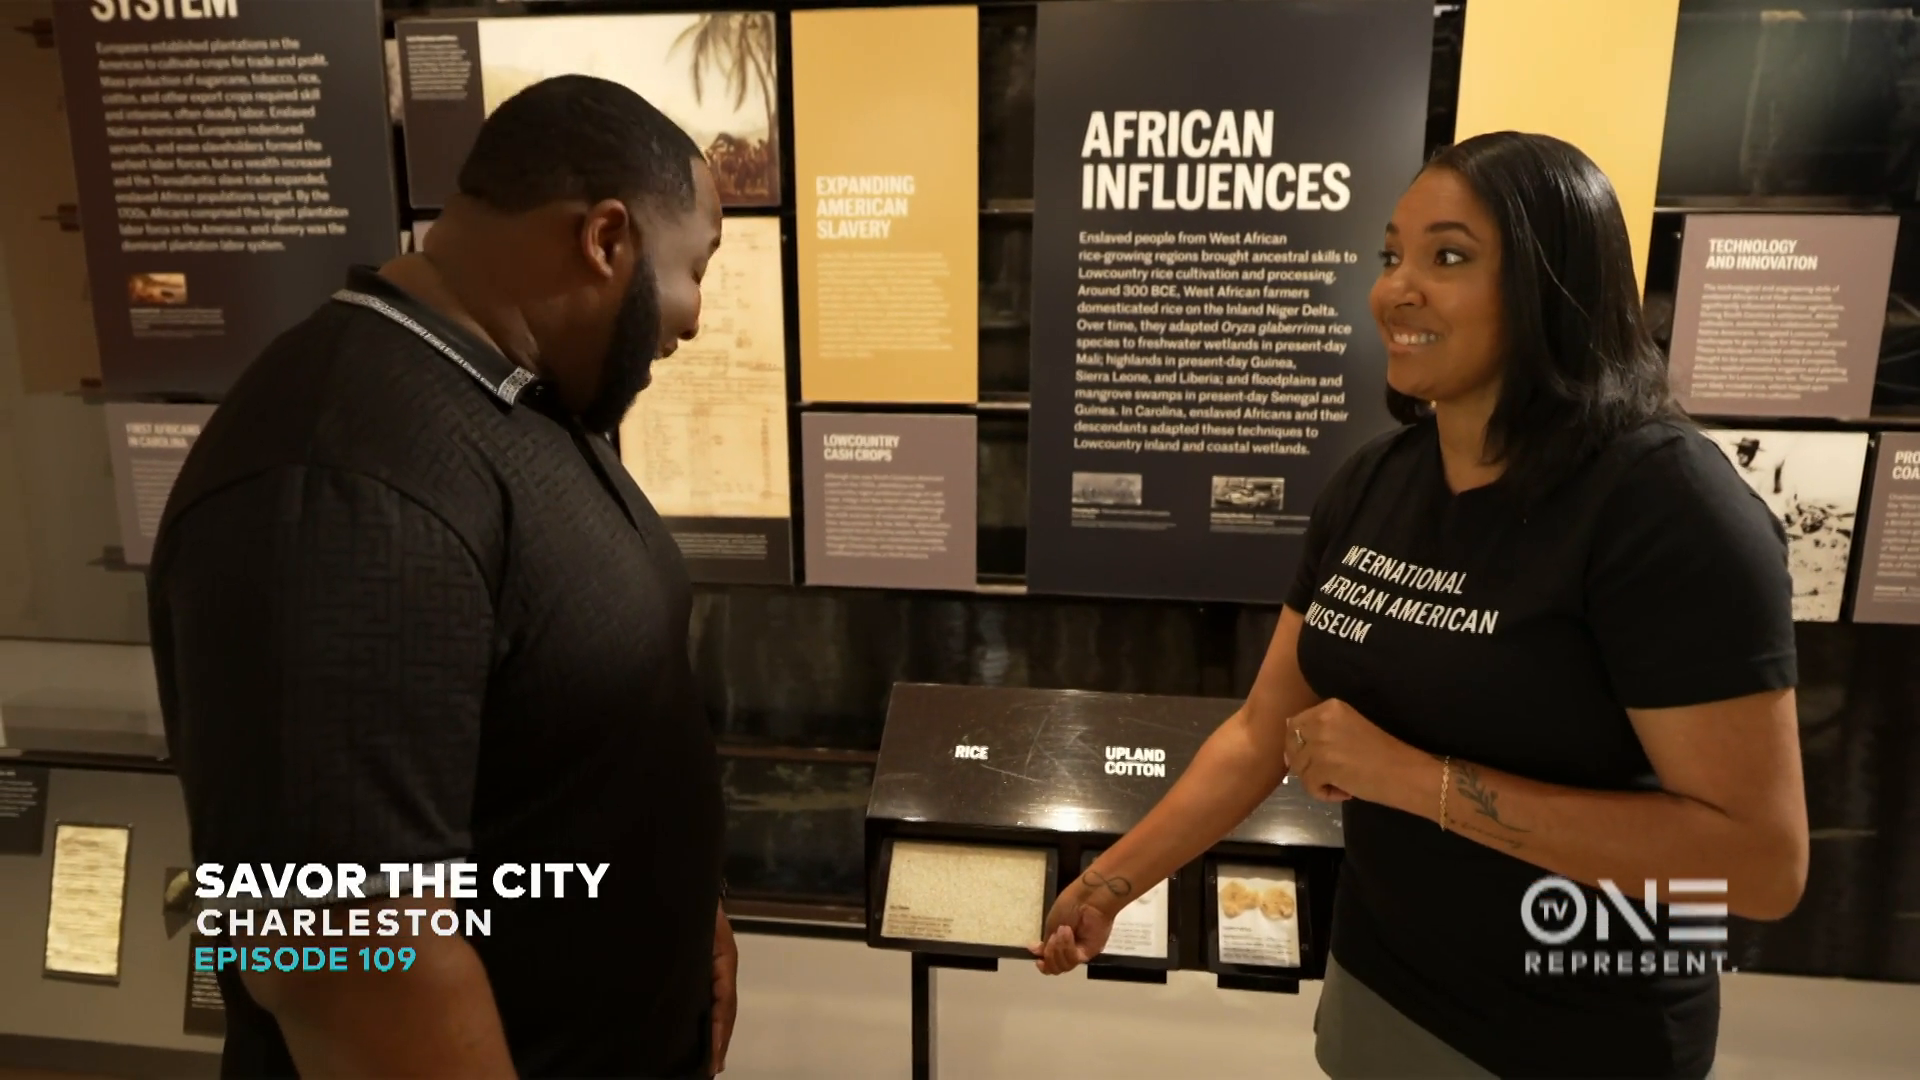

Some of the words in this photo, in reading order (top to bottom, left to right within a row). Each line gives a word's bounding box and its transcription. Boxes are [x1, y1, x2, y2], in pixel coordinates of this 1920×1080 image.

[1081, 109, 1274, 158] AFRICAN
[815, 175, 915, 195] EXPANDING
[1081, 162, 1351, 211] INFLUENCES
[815, 197, 909, 217] AMERICAN
[816, 219, 891, 239] SLAVERY
[1078, 231, 1132, 243] Enslaved
[1134, 231, 1176, 247] people
[1178, 232, 1206, 244] from
[1209, 232, 1240, 244] West
[1243, 232, 1288, 244] African
[1708, 238, 1799, 254] TECHNOLOGY
[1078, 249, 1152, 265] rice-growing
[1154, 250, 1198, 265] regions
[1200, 250, 1249, 265] brought
[1252, 250, 1309, 263] ancestral
[1311, 251, 1341, 263] skills
[1344, 251, 1358, 263] to
[1705, 255, 1735, 270] AND
[1736, 255, 1819, 271] INNOVATION
[1078, 267, 1148, 282] Lowcountry
[1150, 267, 1174, 280] rice
[1175, 268, 1239, 280] cultivation
[1241, 268, 1265, 280] and
[1266, 268, 1336, 284] processing.
[1077, 284, 1120, 297] Around
[1122, 285, 1148, 297] 300
[1150, 285, 1180, 300] BCE,
[1183, 285, 1214, 298] West
[1217, 286, 1260, 298] African
[1262, 286, 1310, 299] farmers
[1076, 301, 1158, 314] domesticated
[1160, 302, 1183, 315] rice
[1185, 306, 1201, 315] on
[1203, 303, 1224, 315] the
[1226, 303, 1264, 316] Inland
[1266, 304, 1298, 319] Niger
[1302, 304, 1338, 317] Delta.
[1076, 318, 1104, 331] Over
[1107, 319, 1136, 334] time,
[1140, 319, 1166, 335] they
[1168, 320, 1219, 335] adapted
[1221, 320, 1256, 336] Oryza
[1258, 321, 1326, 337] glaberrima
[1328, 322, 1352, 335] rice
[1076, 335, 1120, 351] species
[1122, 336, 1136, 348] to
[1138, 336, 1201, 349] freshwater
[1204, 337, 1259, 350] wetlands
[1261, 338, 1272, 351] in
[1274, 339, 1347, 355] present-day
[1075, 353, 1103, 368] Mali;
[1106, 353, 1162, 369] highlands
[1164, 354, 1176, 367] in
[1178, 355, 1248, 371] present-day
[1250, 356, 1296, 372] Guinea,
[1074, 370, 1110, 382] Sierra
[1112, 371, 1150, 386] Leone,
[1154, 371, 1176, 384] and
[1178, 372, 1223, 388] Liberia;
[1226, 373, 1249, 386] and
[1251, 374, 1317, 390] floodplains
[1319, 375, 1343, 388] and
[1074, 389, 1132, 403] mangrove
[1134, 391, 1182, 404] swamps
[1184, 389, 1196, 401] in
[1198, 389, 1268, 406] present-day
[1270, 391, 1320, 407] Senegal
[1322, 392, 1345, 405] and
[1074, 403, 1118, 416] Guinea.
[1121, 404, 1132, 417] In
[1134, 405, 1186, 421] Carolina,
[1188, 406, 1241, 420] enslaved
[1243, 408, 1292, 421] Africans
[1294, 409, 1318, 422] and
[1320, 410, 1348, 422] their
[1073, 420, 1148, 434] descendants
[1150, 422, 1200, 438] adapted
[1201, 423, 1234, 436] these
[1236, 424, 1302, 441] techniques
[1305, 426, 1319, 439] to
[823, 434, 900, 449] LOWCOUNTRY
[1073, 436, 1142, 453] Lowcountry
[1144, 438, 1180, 451] inland
[1182, 439, 1204, 452] and
[1206, 440, 1250, 454] coastal
[1252, 442, 1311, 457] wetlands.
[824, 447, 854, 461] CASH
[855, 448, 893, 463] CROPS
[1320, 573, 1391, 615] AFRICAN
[1385, 597, 1500, 636] AMERICAN
[954, 745, 989, 760] RICE
[1105, 746, 1166, 763] UPLAND
[1104, 761, 1166, 777] COTTON
